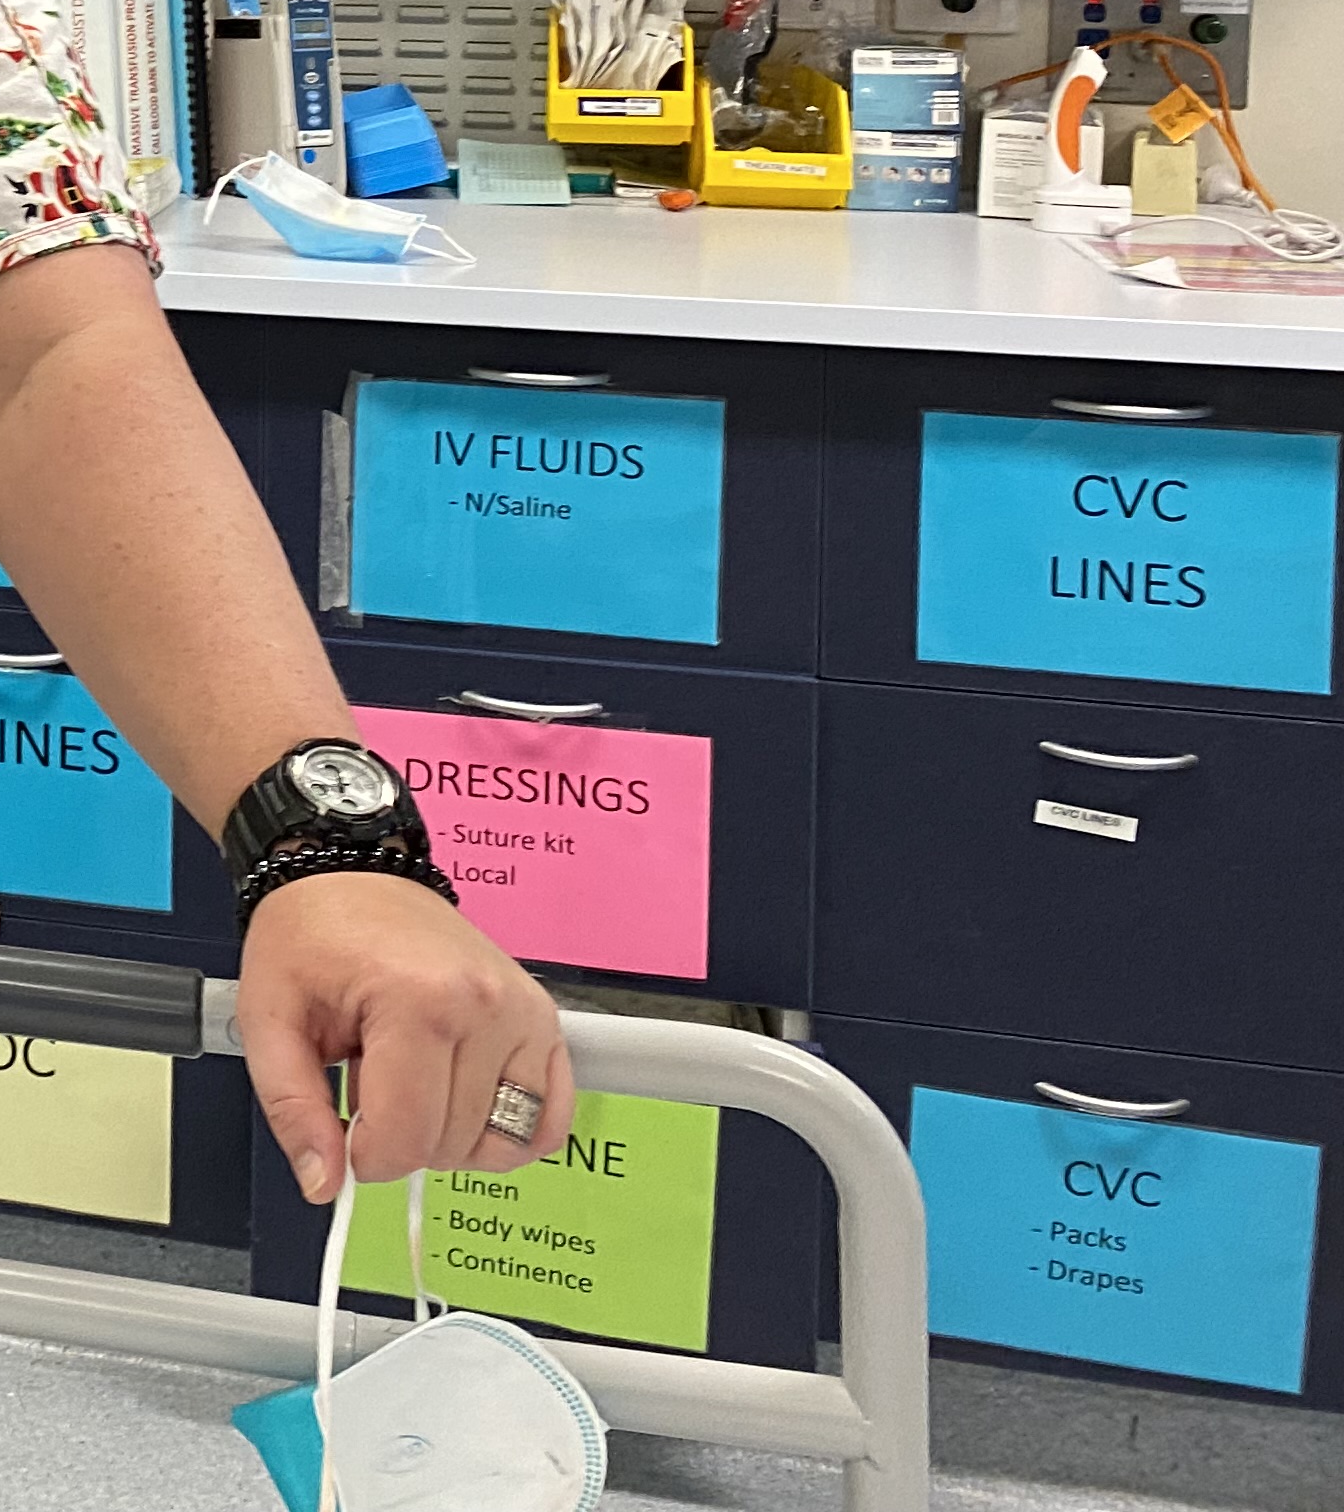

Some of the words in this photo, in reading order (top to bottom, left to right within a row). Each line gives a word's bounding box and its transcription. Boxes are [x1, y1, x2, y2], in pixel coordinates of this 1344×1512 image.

[144, 2, 156, 50] ACTIVATE
[126, 24, 140, 102] TRANSFUSION
[146, 52, 157, 64] TO
[146, 66, 158, 94] BANK
[129, 106, 142, 155] MASSIVE
[147, 96, 160, 132] BLOOD
[149, 134, 160, 154] CALL
[434, 430, 475, 466] IV
[490, 434, 644, 479] FLUIDS
[465, 492, 572, 520] N/Saline
[1074, 474, 1188, 522] CVC
[1050, 556, 1207, 608] LINES
[405, 758, 650, 816] DRESSINGS
[1051, 806, 1080, 818] CVC
[1082, 812, 1120, 826] LINES
[453, 824, 535, 851] Suture
[544, 832, 575, 856] kit
[453, 861, 516, 886] Local
[452, 1172, 519, 1202] Linen
[1064, 1160, 1162, 1209] CVC
[450, 1210, 512, 1242] Body
[522, 1224, 596, 1255] wipes
[1050, 1221, 1127, 1254] Packs
[448, 1248, 594, 1294] Continence
[1048, 1260, 1144, 1296] Drapes
